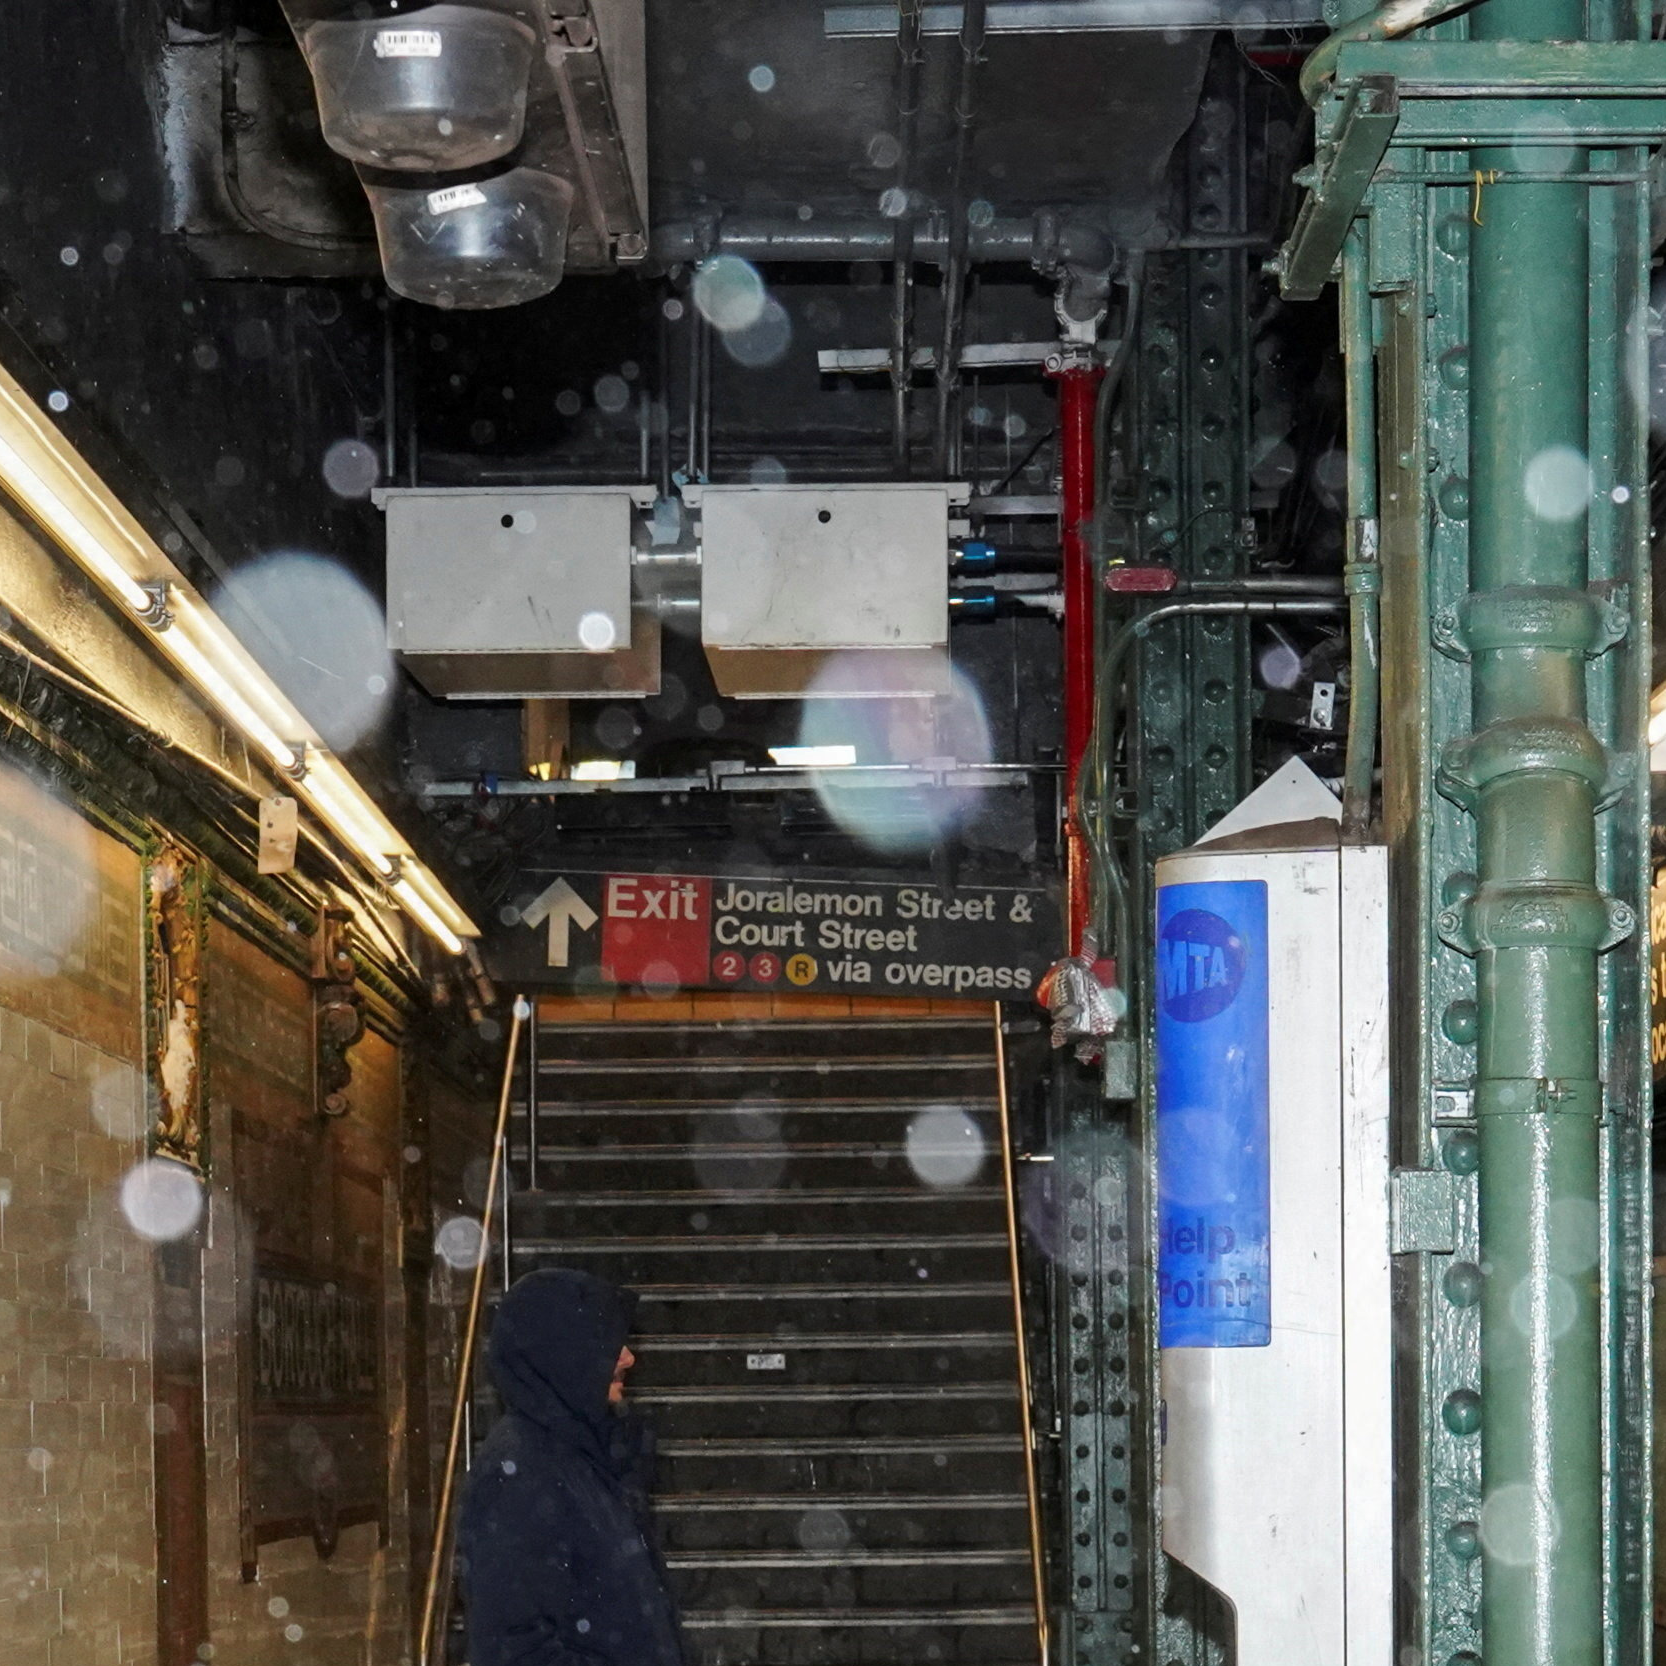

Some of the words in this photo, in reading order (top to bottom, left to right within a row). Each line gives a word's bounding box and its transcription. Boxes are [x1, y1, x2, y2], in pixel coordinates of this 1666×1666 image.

[607, 877, 698, 921] Exit
[716, 882, 883, 917] Joralemon
[896, 889, 996, 921] Street
[1009, 894, 1033, 923] &
[715, 915, 806, 947] Court
[818, 919, 918, 952] Street
[722, 956, 737, 976] 2
[758, 958, 773, 977] 3
[794, 960, 809, 978] R
[827, 954, 871, 983] via
[885, 962, 1032, 993] overpass
[1162, 939, 1228, 1000] MTA
